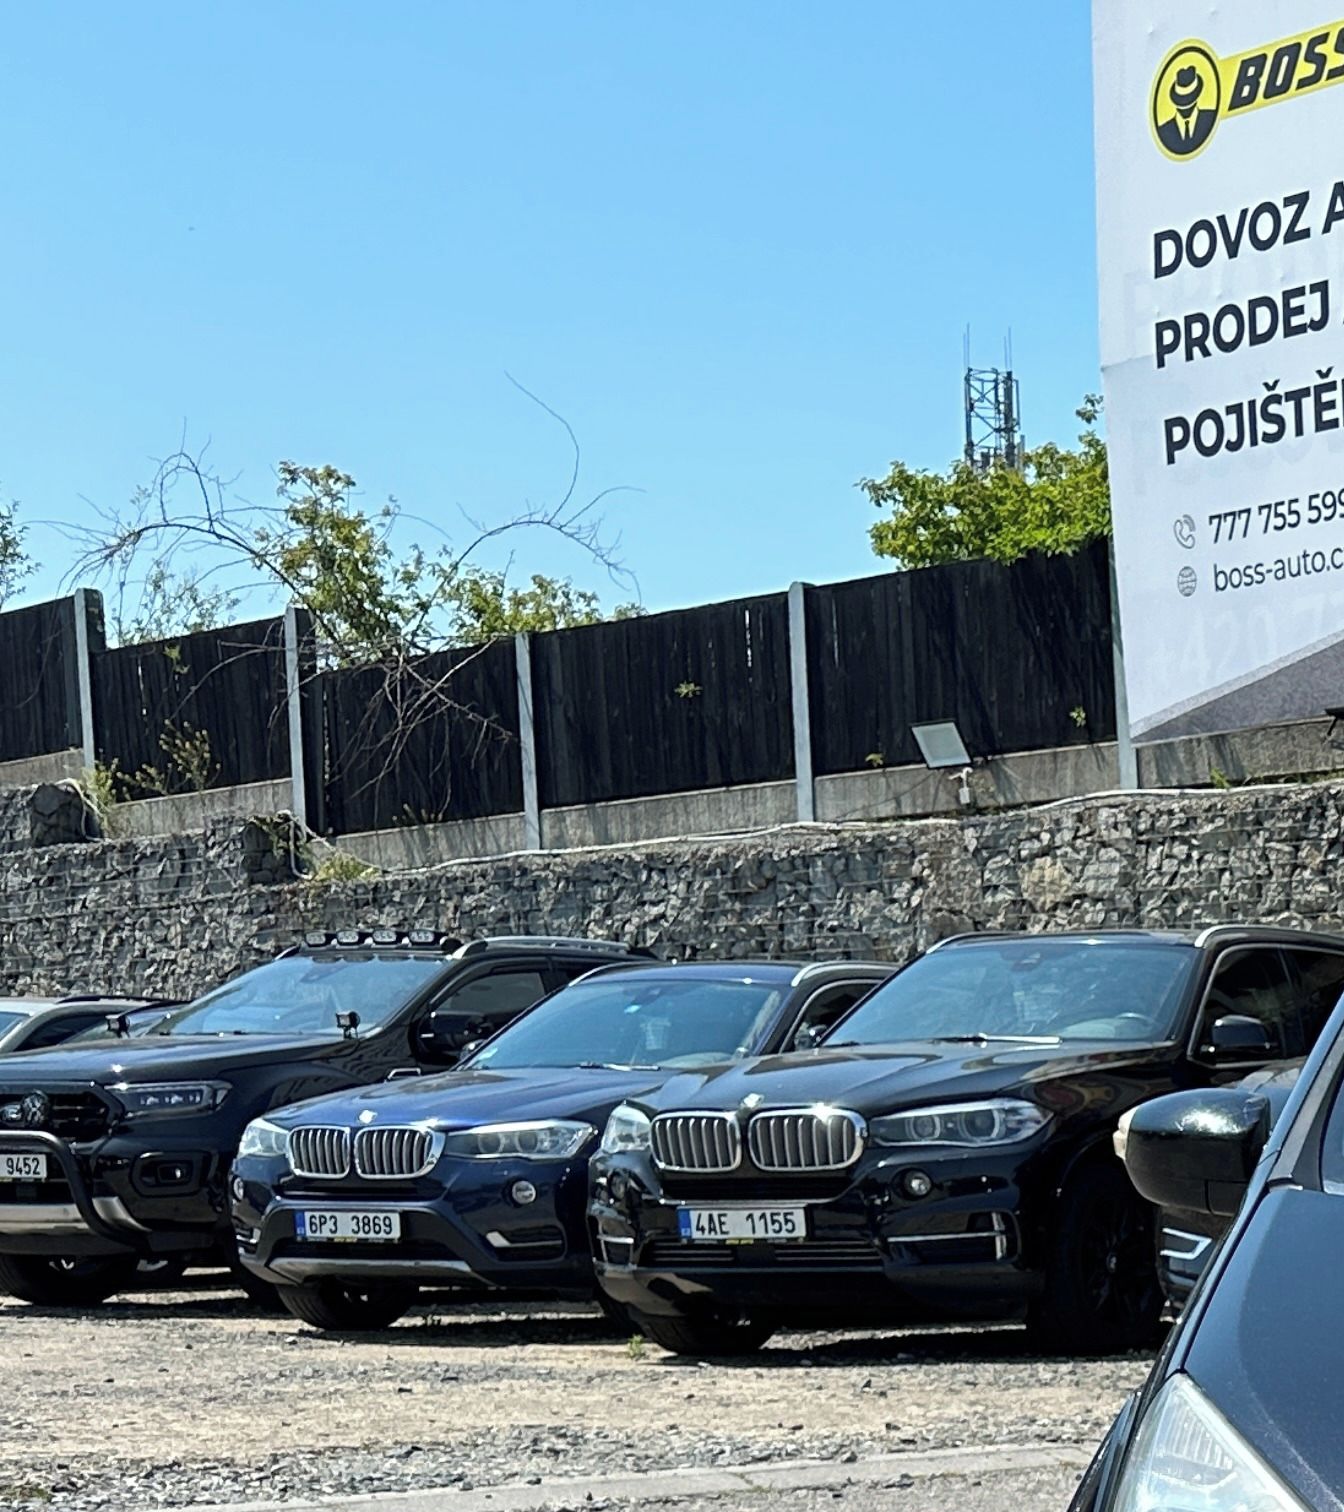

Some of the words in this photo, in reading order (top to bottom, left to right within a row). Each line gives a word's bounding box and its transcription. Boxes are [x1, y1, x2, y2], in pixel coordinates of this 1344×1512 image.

[1153, 191, 1311, 279] DOVOZ
[1154, 280, 1330, 369] PRODEJ
[1208, 508, 1252, 544] 777
[1258, 498, 1301, 534] 755
[6, 1157, 41, 1176] 9452
[309, 1214, 338, 1235] 6P3
[351, 1215, 393, 1235] 3869
[695, 1212, 730, 1235] 4AE
[746, 1211, 796, 1234] 1155
